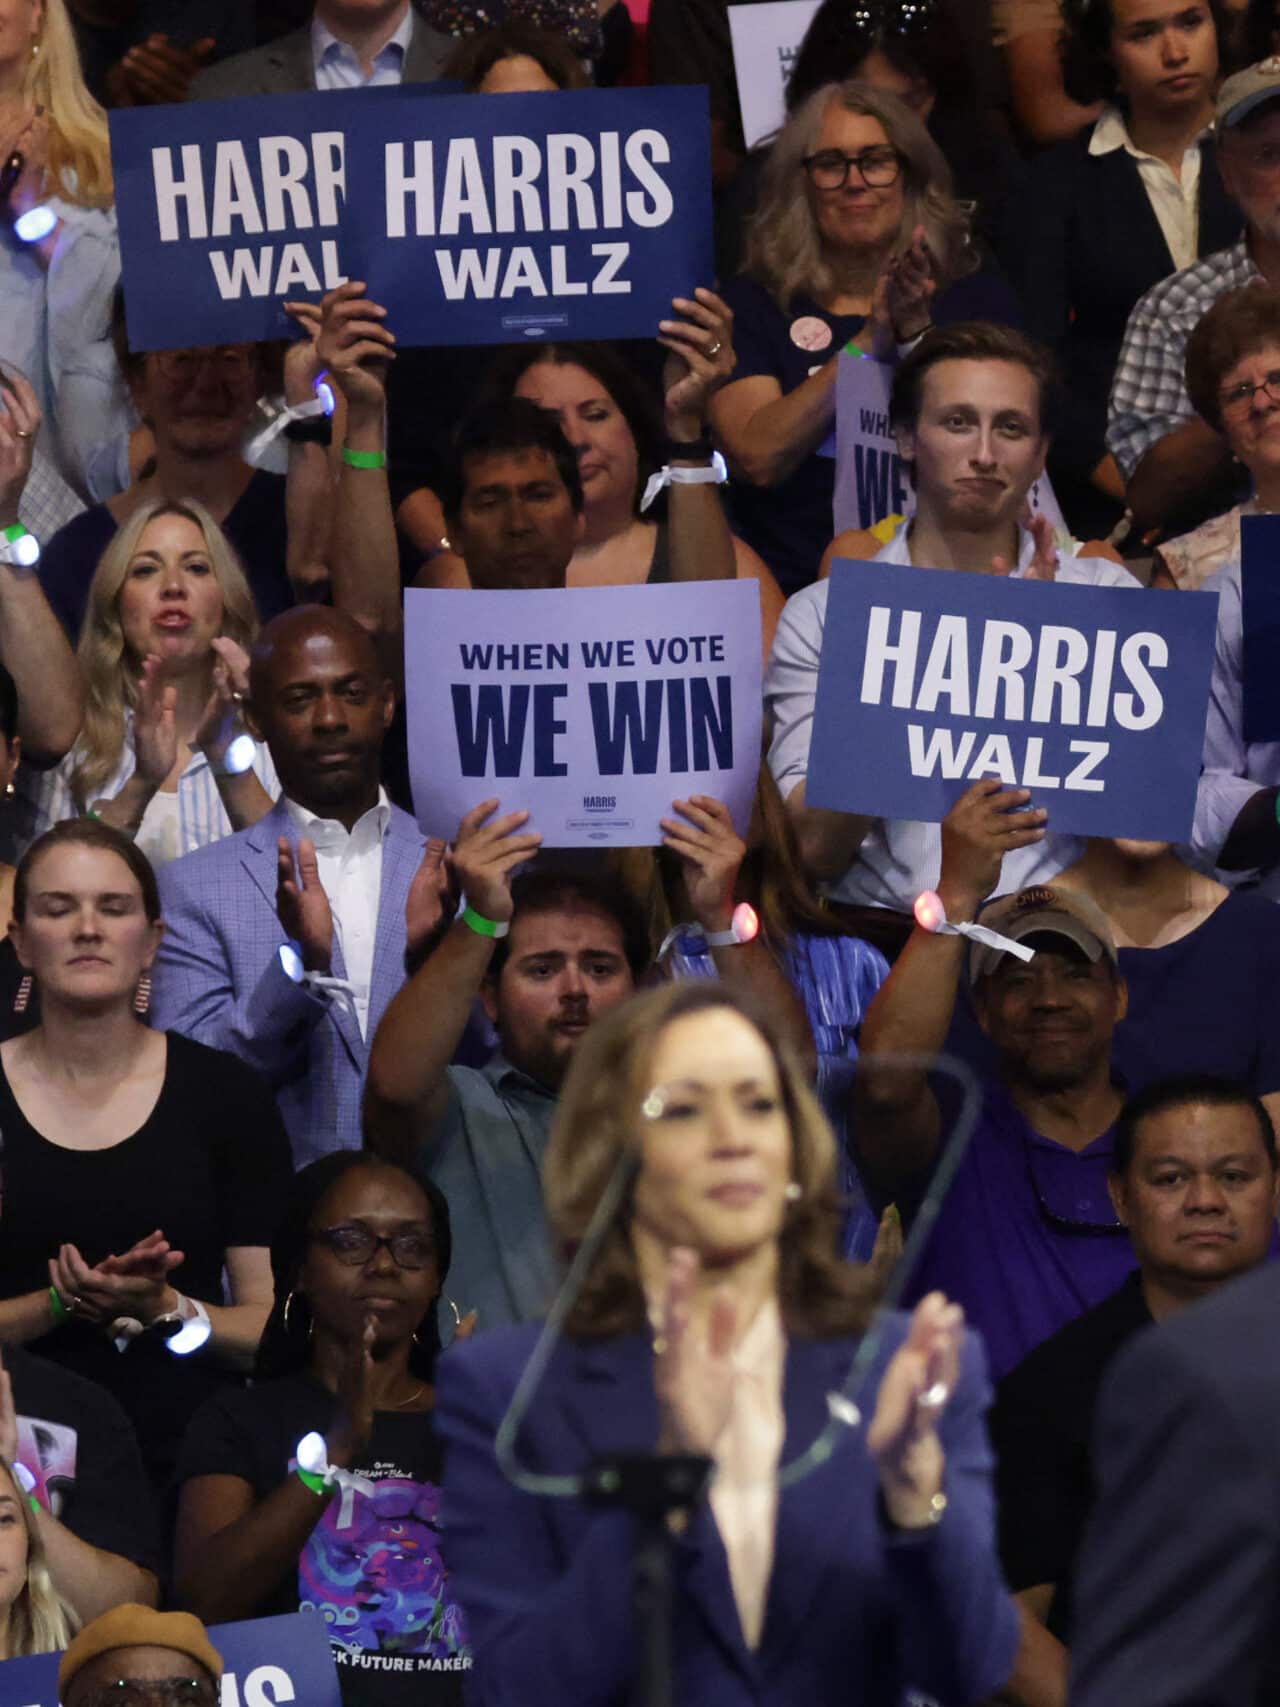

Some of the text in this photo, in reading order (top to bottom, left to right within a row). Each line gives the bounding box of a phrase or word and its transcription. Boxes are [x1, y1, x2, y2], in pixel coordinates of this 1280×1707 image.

[386, 128, 674, 238] HARRIS
[435, 242, 632, 300] WALZ
[459, 634, 726, 671] WHEN WE VOTE
[860, 606, 1169, 730] HARRIS
[450, 675, 734, 778] WE WIN
[907, 723, 1110, 792] WALZ
[351, 1655, 415, 1672] FUTURE
